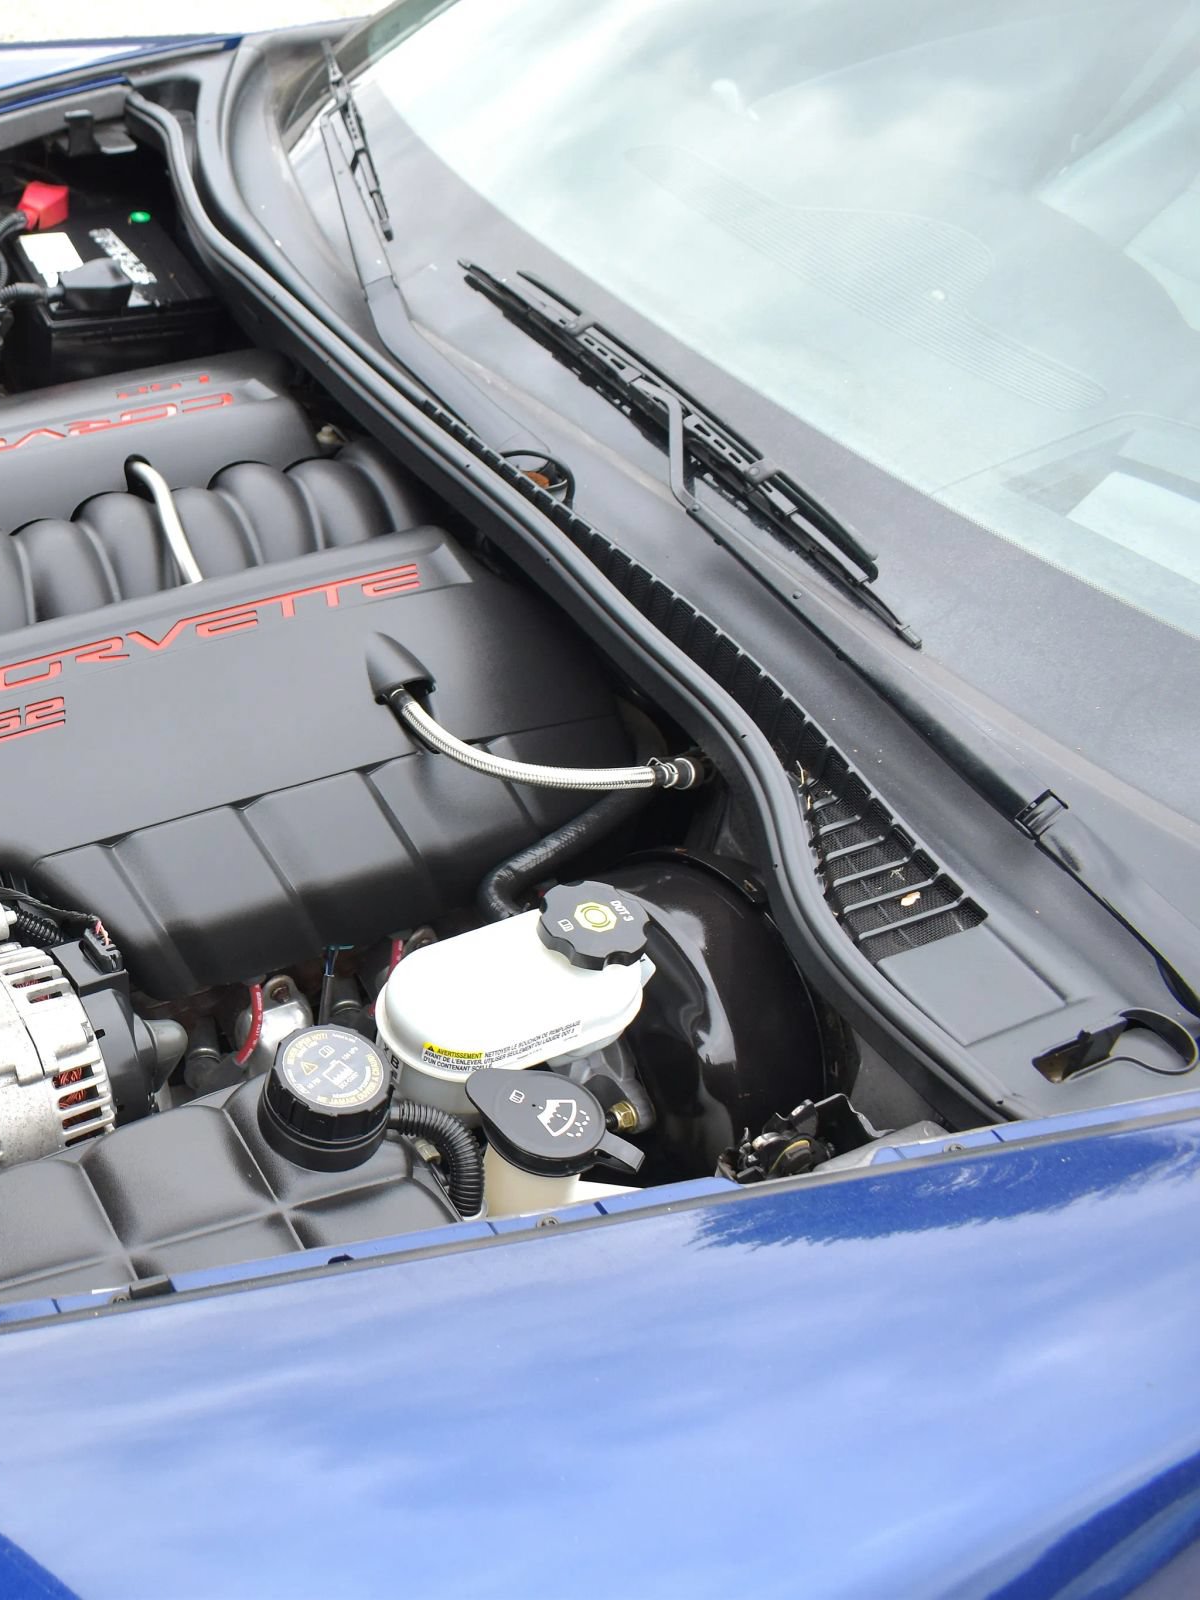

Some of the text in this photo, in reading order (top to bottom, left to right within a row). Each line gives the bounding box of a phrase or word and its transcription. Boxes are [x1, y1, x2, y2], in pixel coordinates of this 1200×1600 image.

[610, 900, 634, 922] DOT 3
[425, 1050, 441, 1060] AVANT
[438, 1048, 483, 1059] AVERTISSEMENT
[423, 1056, 436, 1065] D'UN
[437, 1060, 470, 1071] CONTENANT
